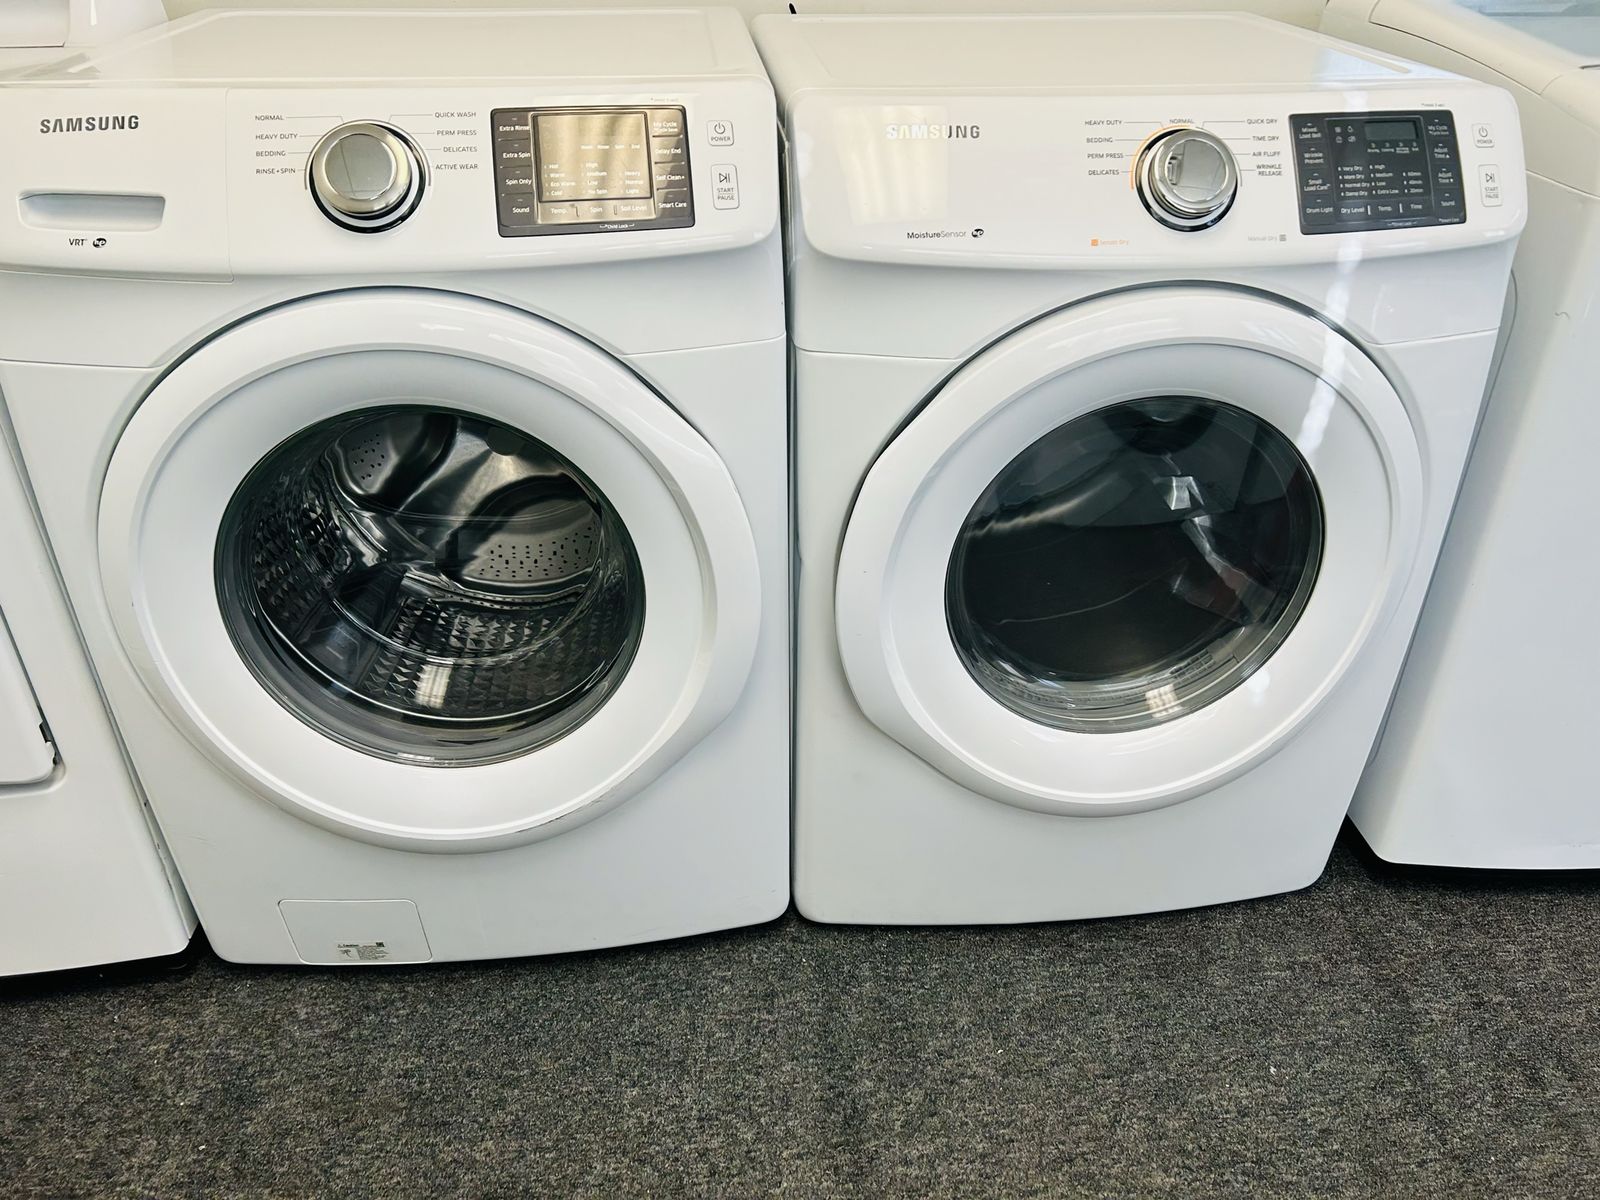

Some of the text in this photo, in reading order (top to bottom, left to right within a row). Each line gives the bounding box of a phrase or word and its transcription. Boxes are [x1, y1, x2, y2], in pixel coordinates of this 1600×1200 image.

[40, 115, 139, 133] SAMSUNG
[887, 125, 980, 139] SAMSUNG
[907, 230, 967, 239] MoistureSensor
